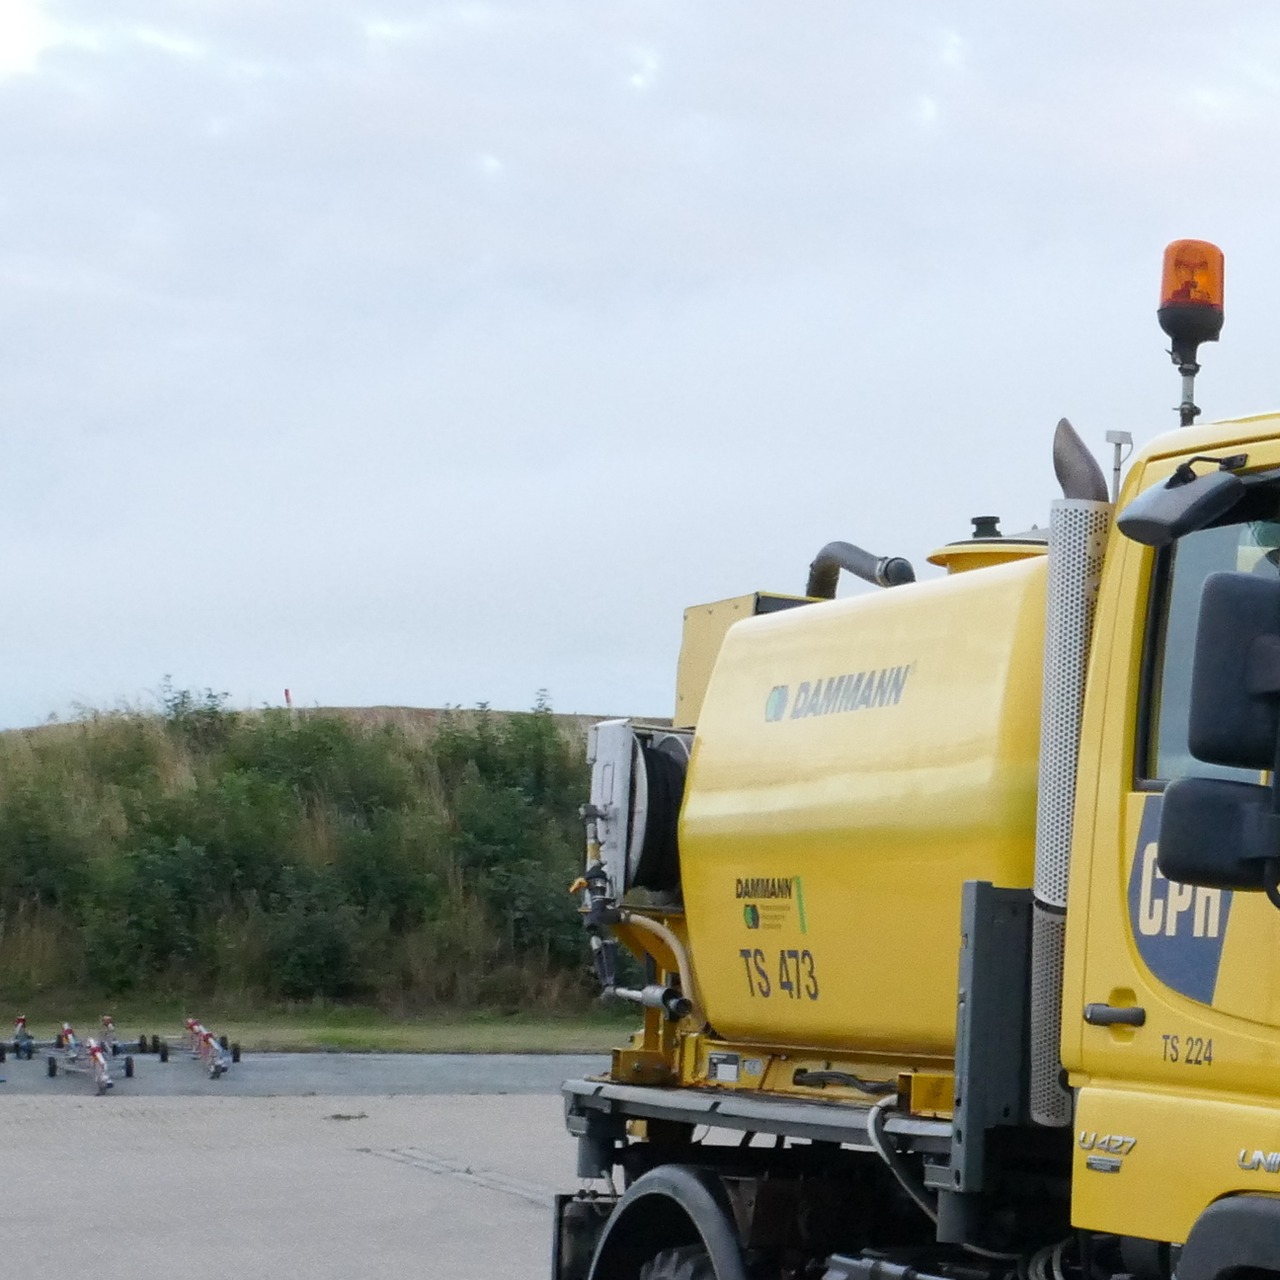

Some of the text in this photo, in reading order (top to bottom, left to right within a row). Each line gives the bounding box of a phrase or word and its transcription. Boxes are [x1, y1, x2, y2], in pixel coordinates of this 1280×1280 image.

[791, 664, 910, 720] DAMMANN
[736, 877, 793, 899] DAMMANN
[739, 948, 819, 1001] TS 473
[1162, 1034, 1213, 1066] TS 224
[1097, 1135, 1137, 1155] 427
